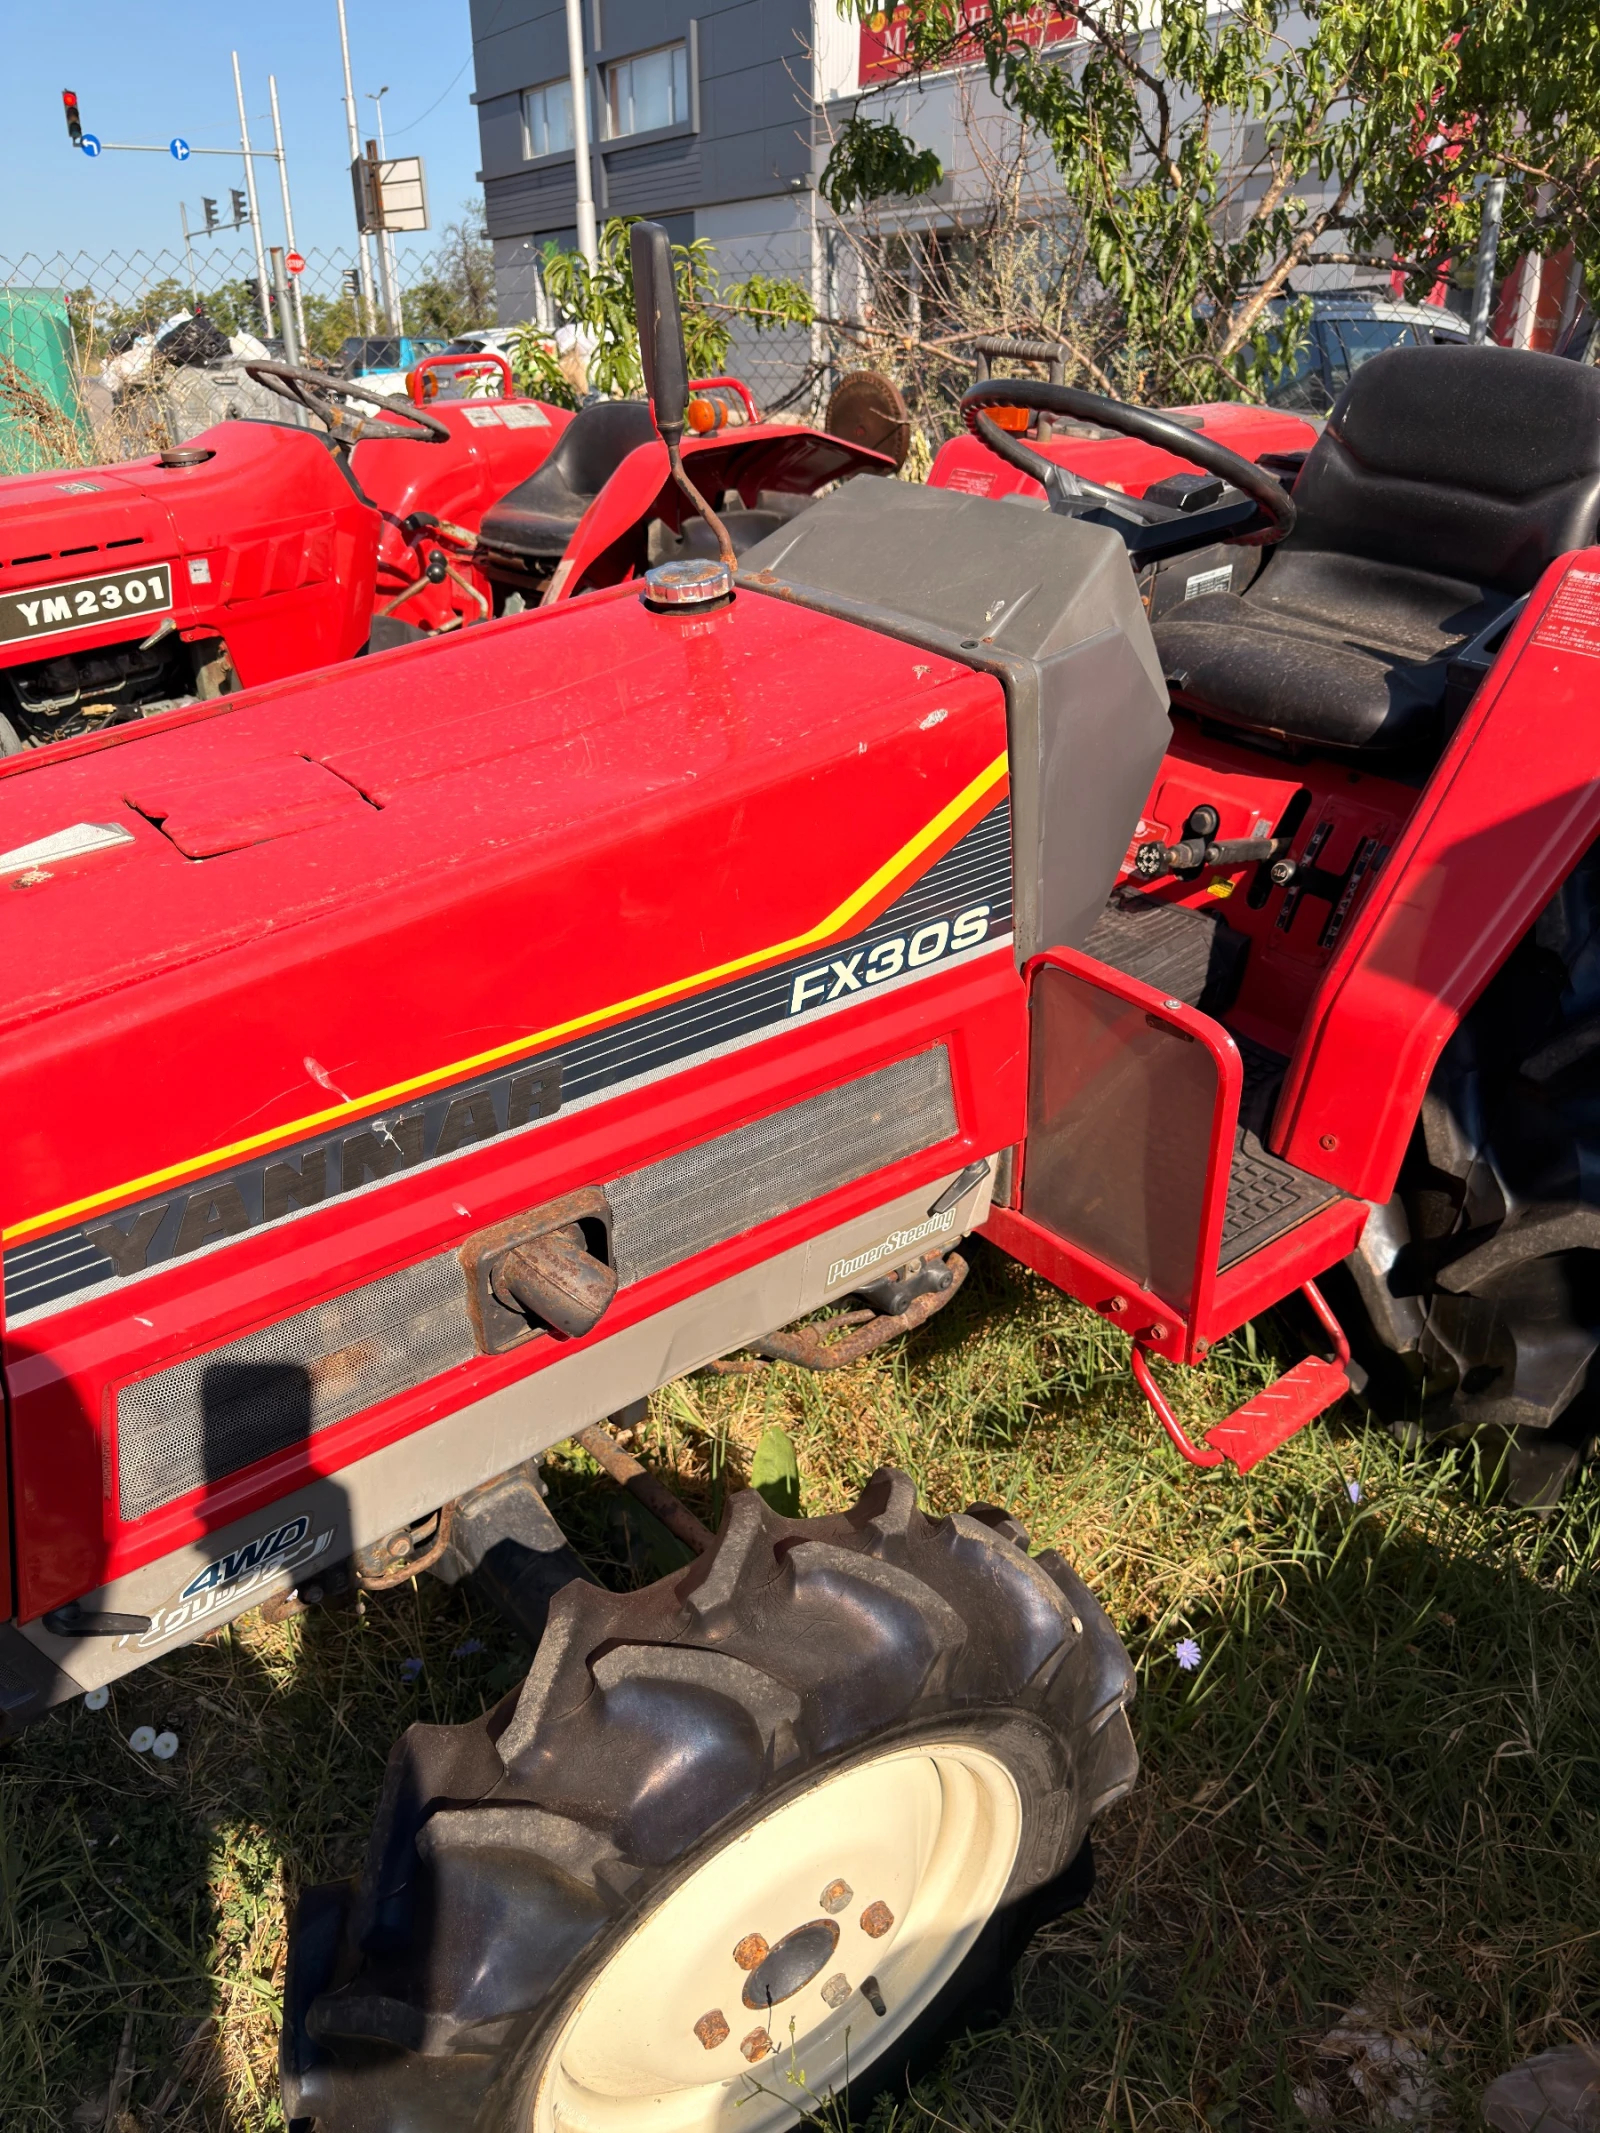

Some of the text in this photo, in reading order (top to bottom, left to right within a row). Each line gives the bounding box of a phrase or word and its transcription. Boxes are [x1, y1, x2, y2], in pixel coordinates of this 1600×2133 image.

[16, 576, 164, 626] YM2301
[788, 903, 991, 1015] FX30S
[82, 1063, 562, 1277] YANMAR
[118, 1528, 334, 1647] イグリップターン
[178, 1515, 310, 1602] 4WD
